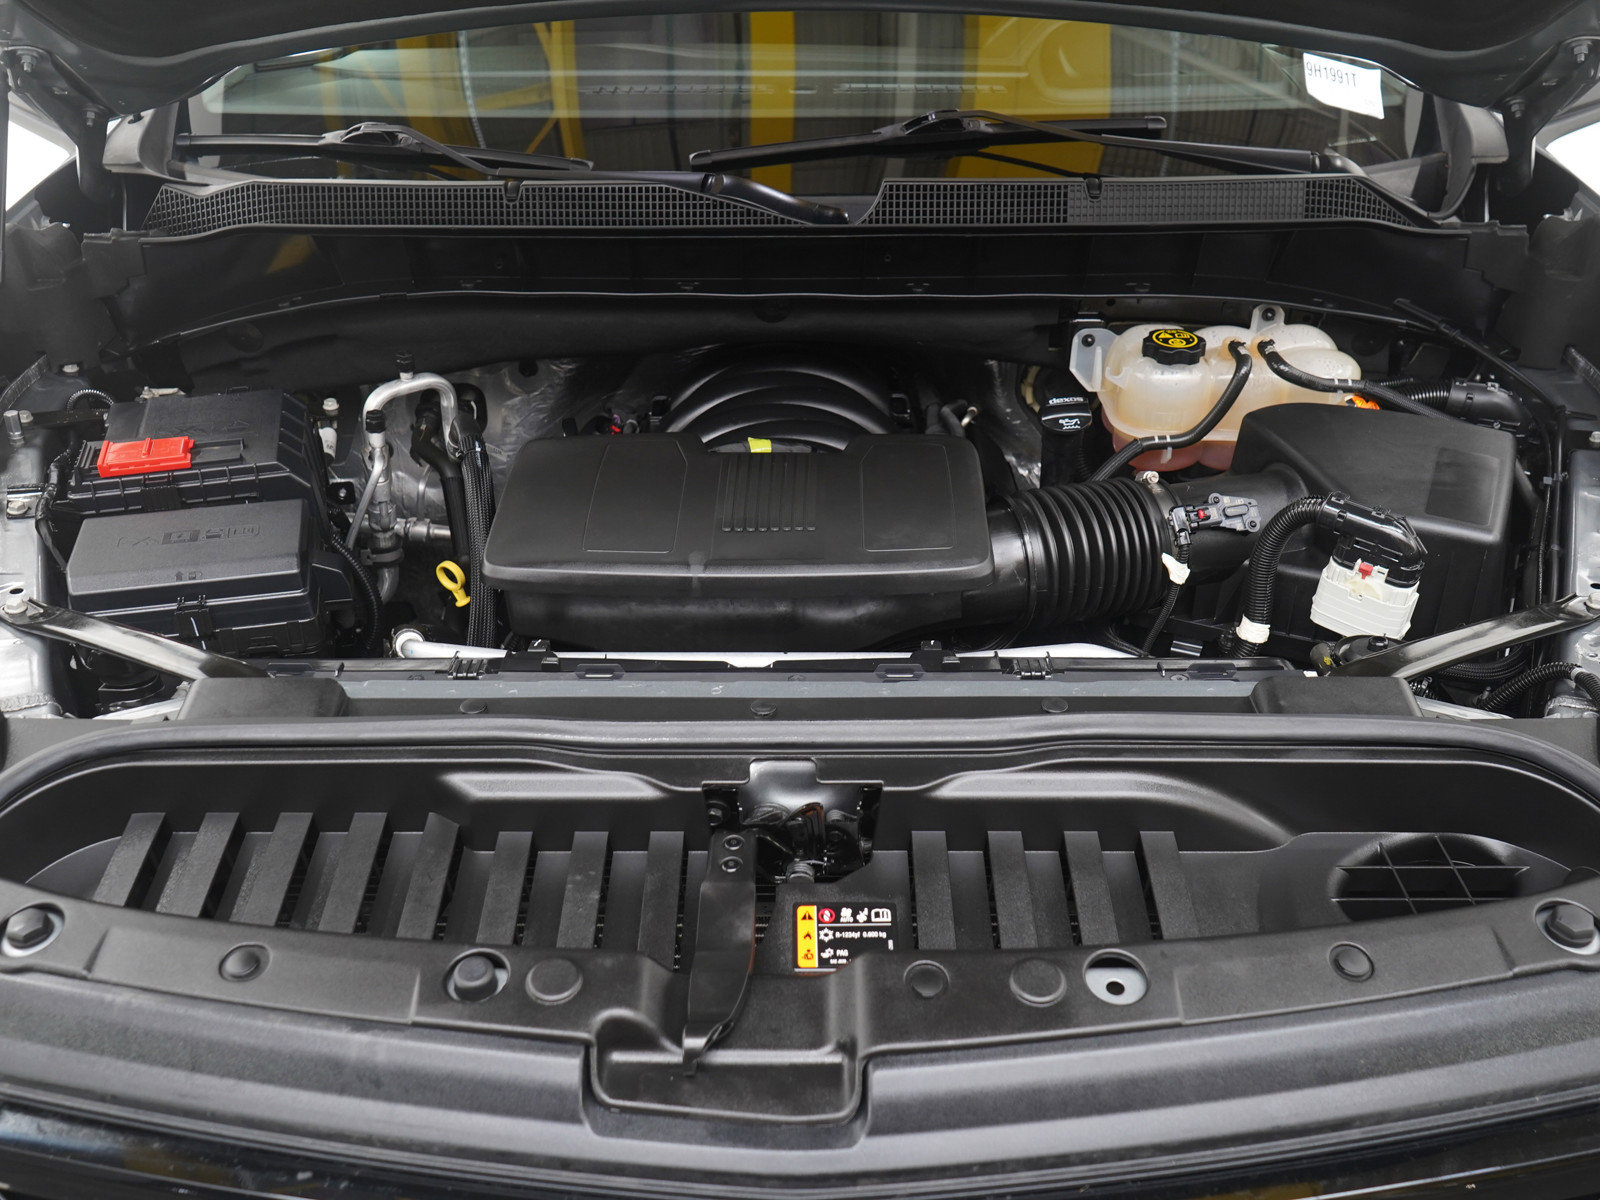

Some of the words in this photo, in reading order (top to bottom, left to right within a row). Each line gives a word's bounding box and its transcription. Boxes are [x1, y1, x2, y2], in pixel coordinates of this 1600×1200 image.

[1305, 60, 1357, 88] 9H1991T
[1048, 396, 1084, 405] dexos
[836, 949, 849, 957] PAG
